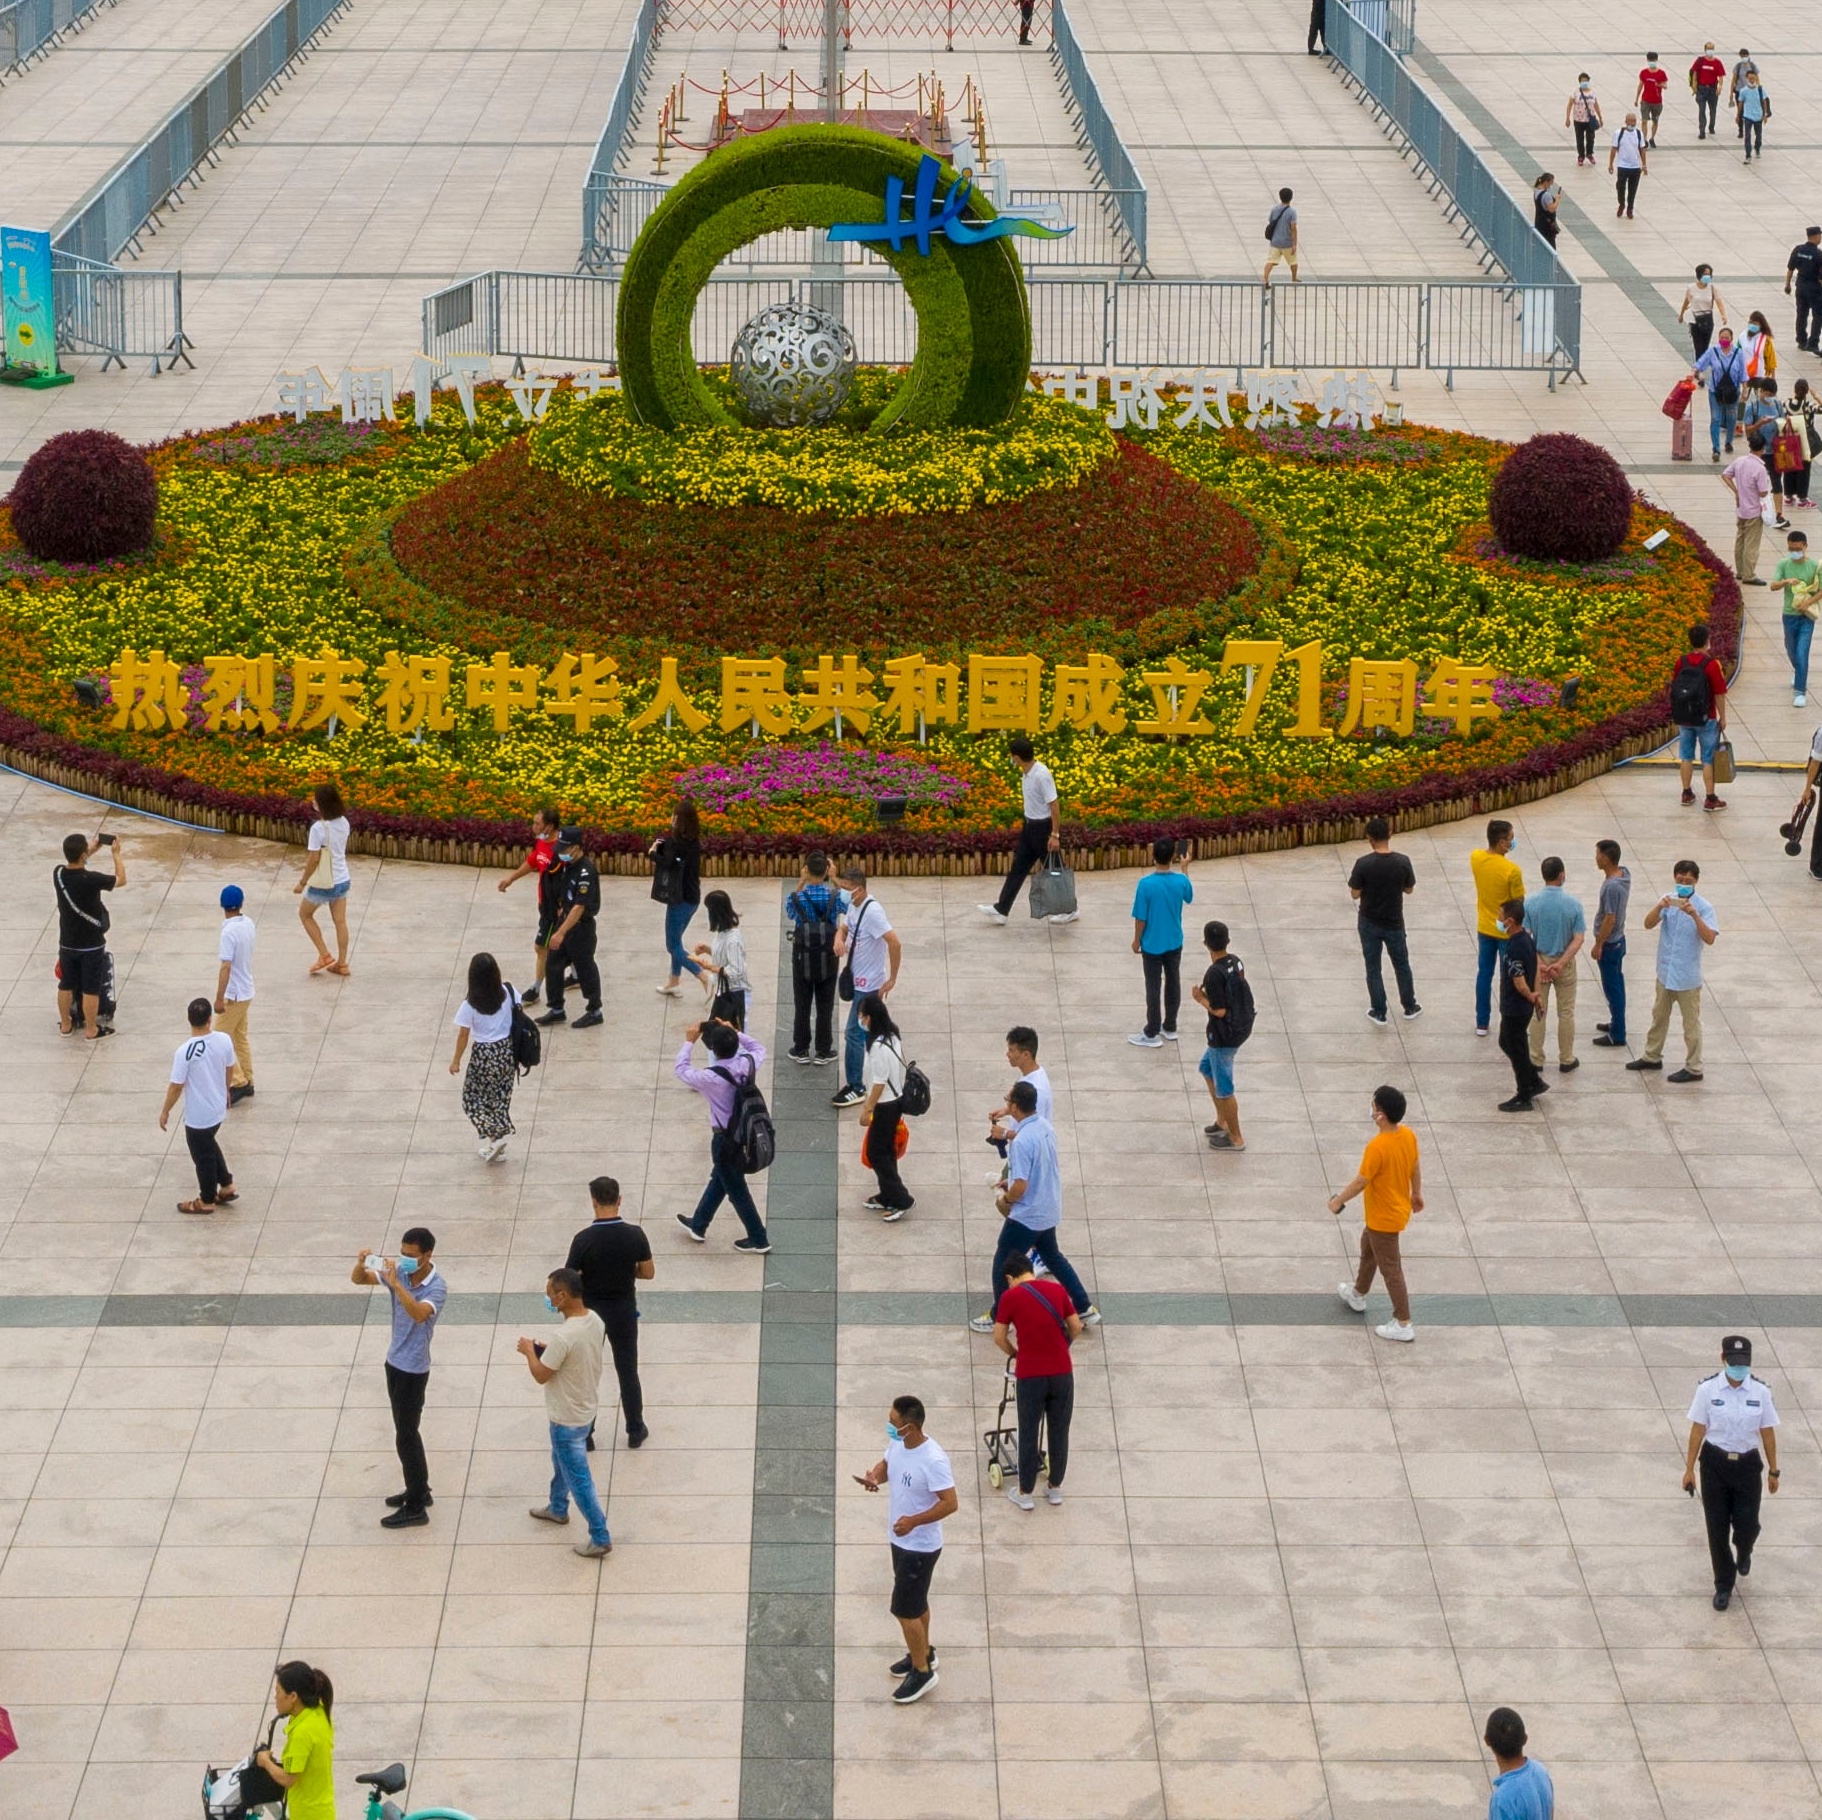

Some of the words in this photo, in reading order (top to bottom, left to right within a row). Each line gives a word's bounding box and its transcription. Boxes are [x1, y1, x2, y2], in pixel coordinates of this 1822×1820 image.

[108, 640, 1503, 737] 热烈庆祝中华人民共和国成立71周年
